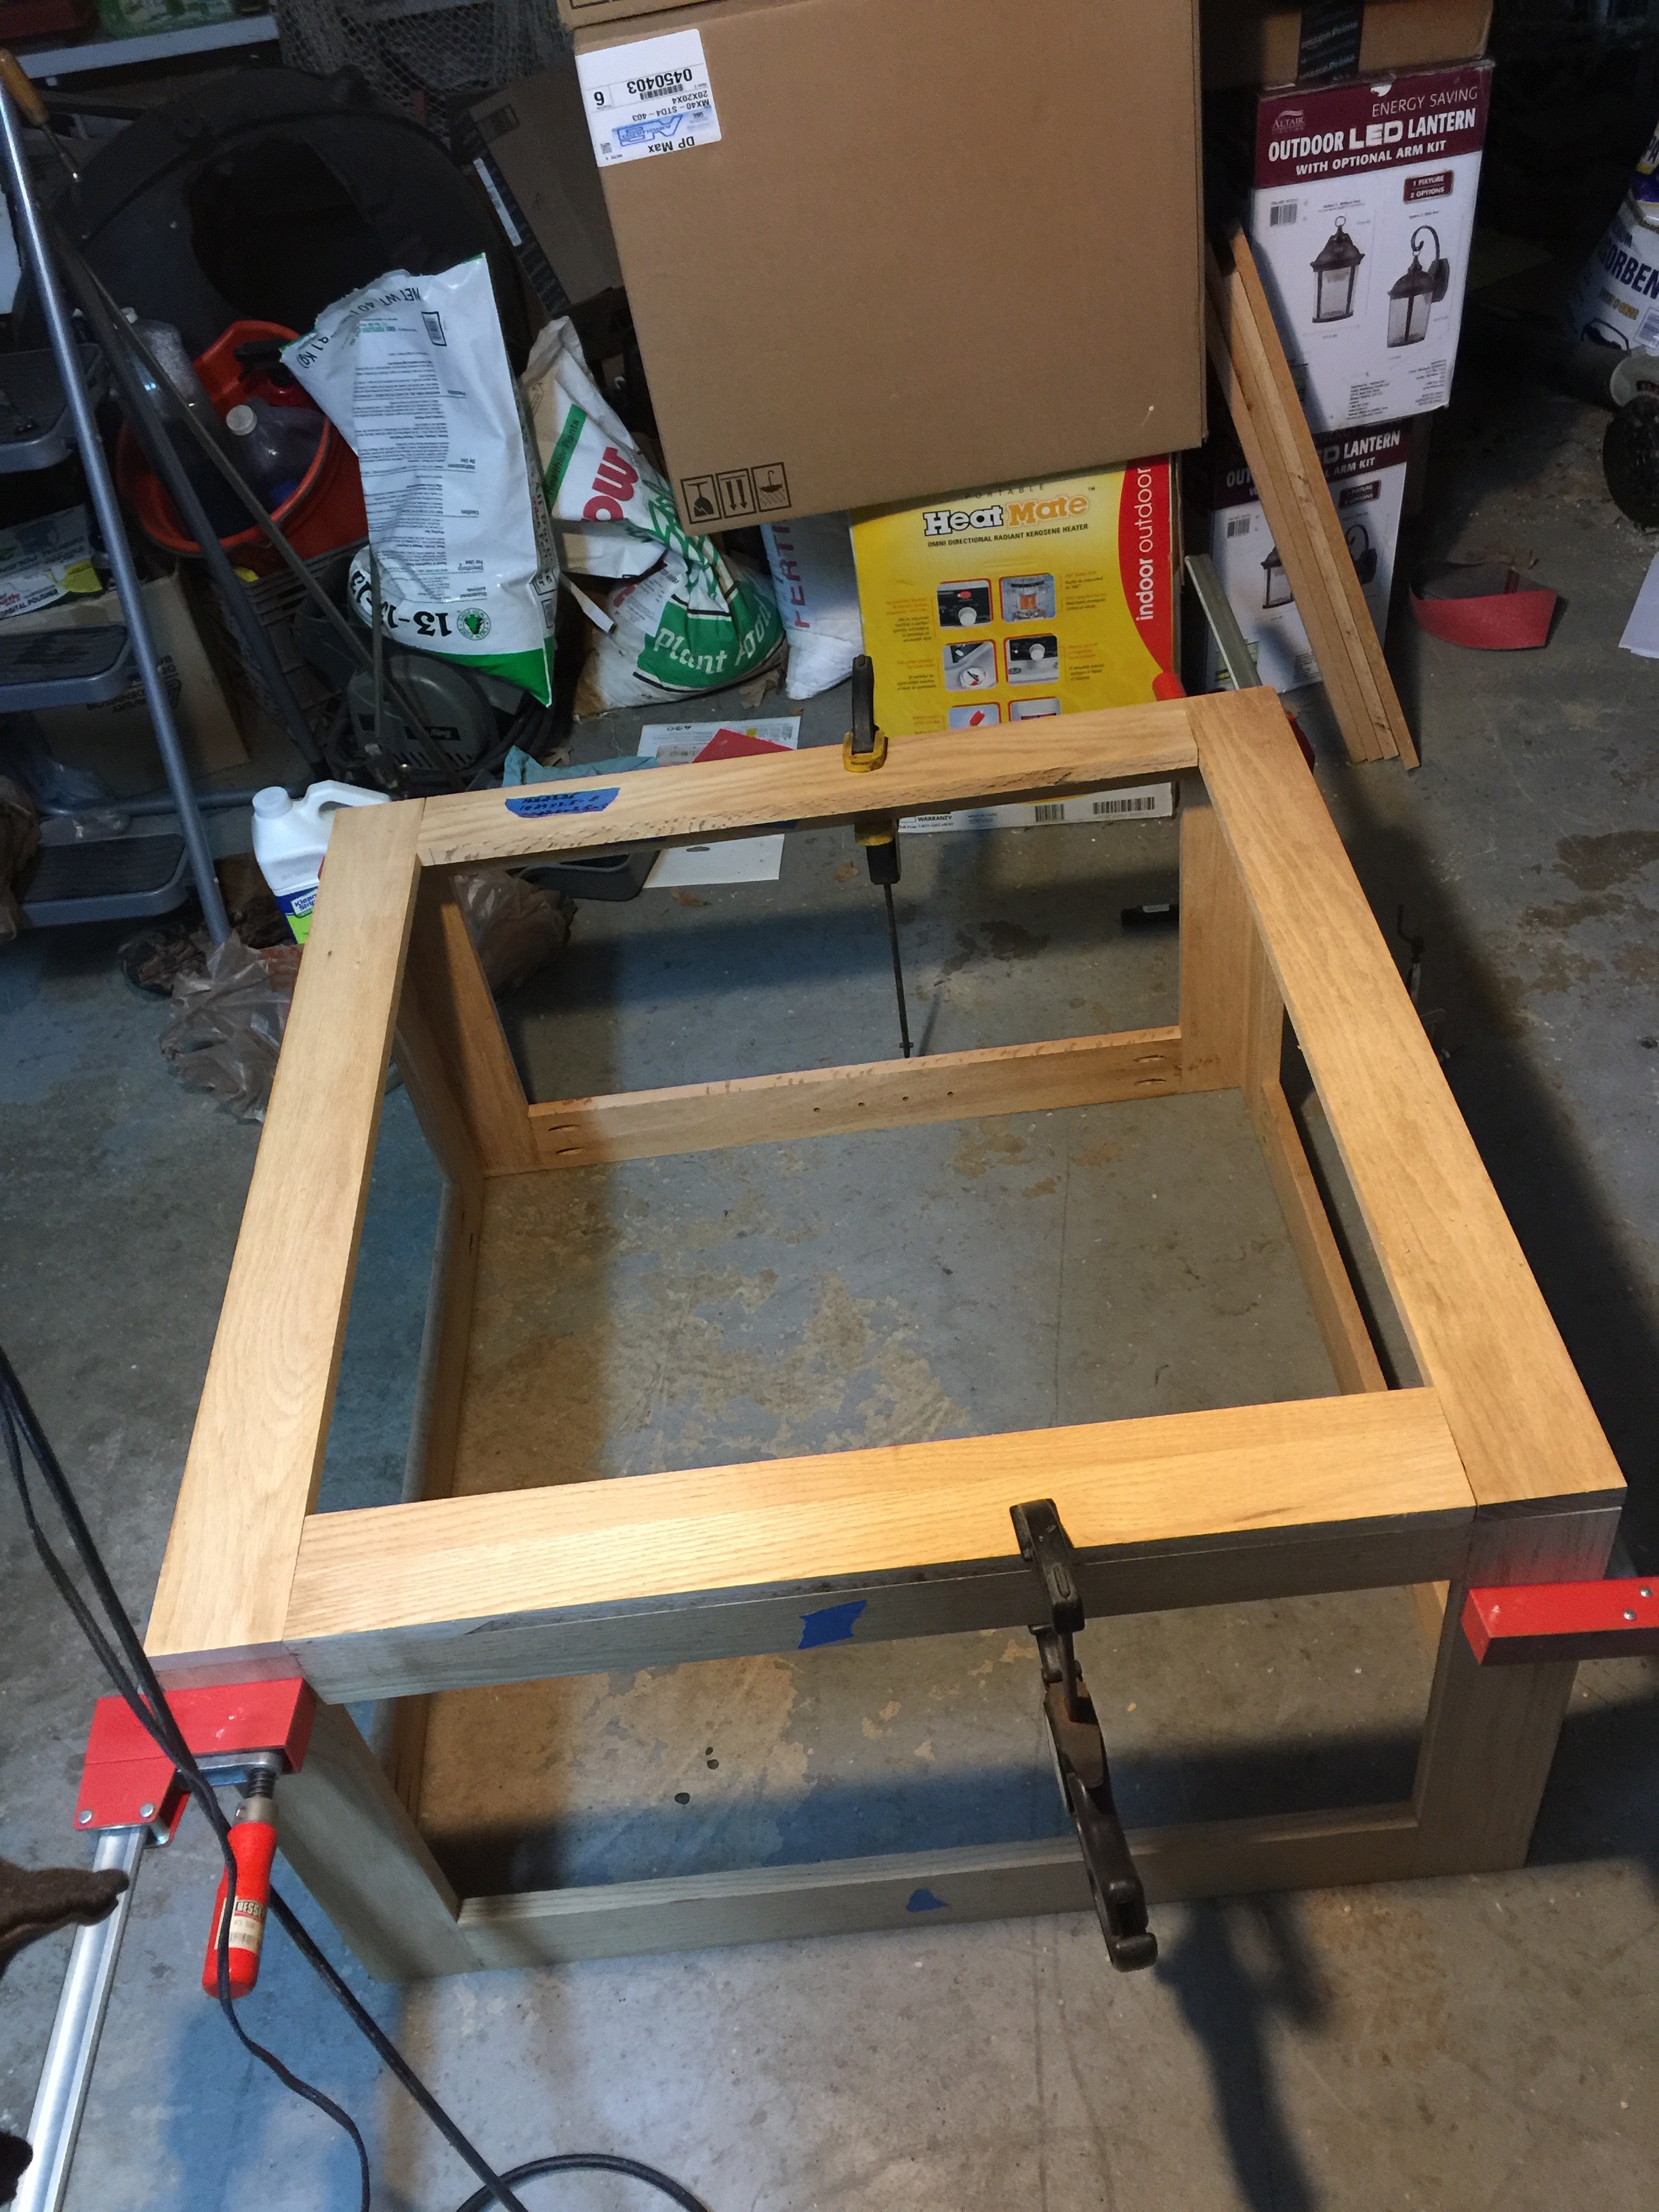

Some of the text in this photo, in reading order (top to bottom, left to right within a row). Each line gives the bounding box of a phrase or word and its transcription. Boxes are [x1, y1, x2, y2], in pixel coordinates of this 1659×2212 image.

[627, 68, 693, 94] 0450403
[594, 91, 605, 106] 6
[672, 91, 708, 103] 20X20X4
[1371, 85, 1479, 118] ENERGY SAVING
[1268, 107, 1477, 163] OUTDOOR LED LANTERN
[648, 136, 695, 153] DP Max
[1296, 139, 1448, 176] WITH OPTIONAL ARM KIT
[1418, 174, 1446, 186] FIXTURE
[1416, 186, 1446, 198] OPTIONS
[378, 292, 400, 307] WT
[400, 287, 422, 302] NET
[1343, 429, 1401, 459] LANTERN
[1358, 456, 1376, 470] KIT
[922, 504, 1004, 537] Heat
[1007, 493, 1090, 529] Mate
[947, 535, 992, 546] DIRECTIONAL
[994, 531, 1025, 541] RADIANT
[1025, 527, 1062, 538] KEROSENE
[1062, 523, 1089, 533] HEATER
[1132, 466, 1155, 622] indoor outdoor
[294, 893, 317, 907] Klean
